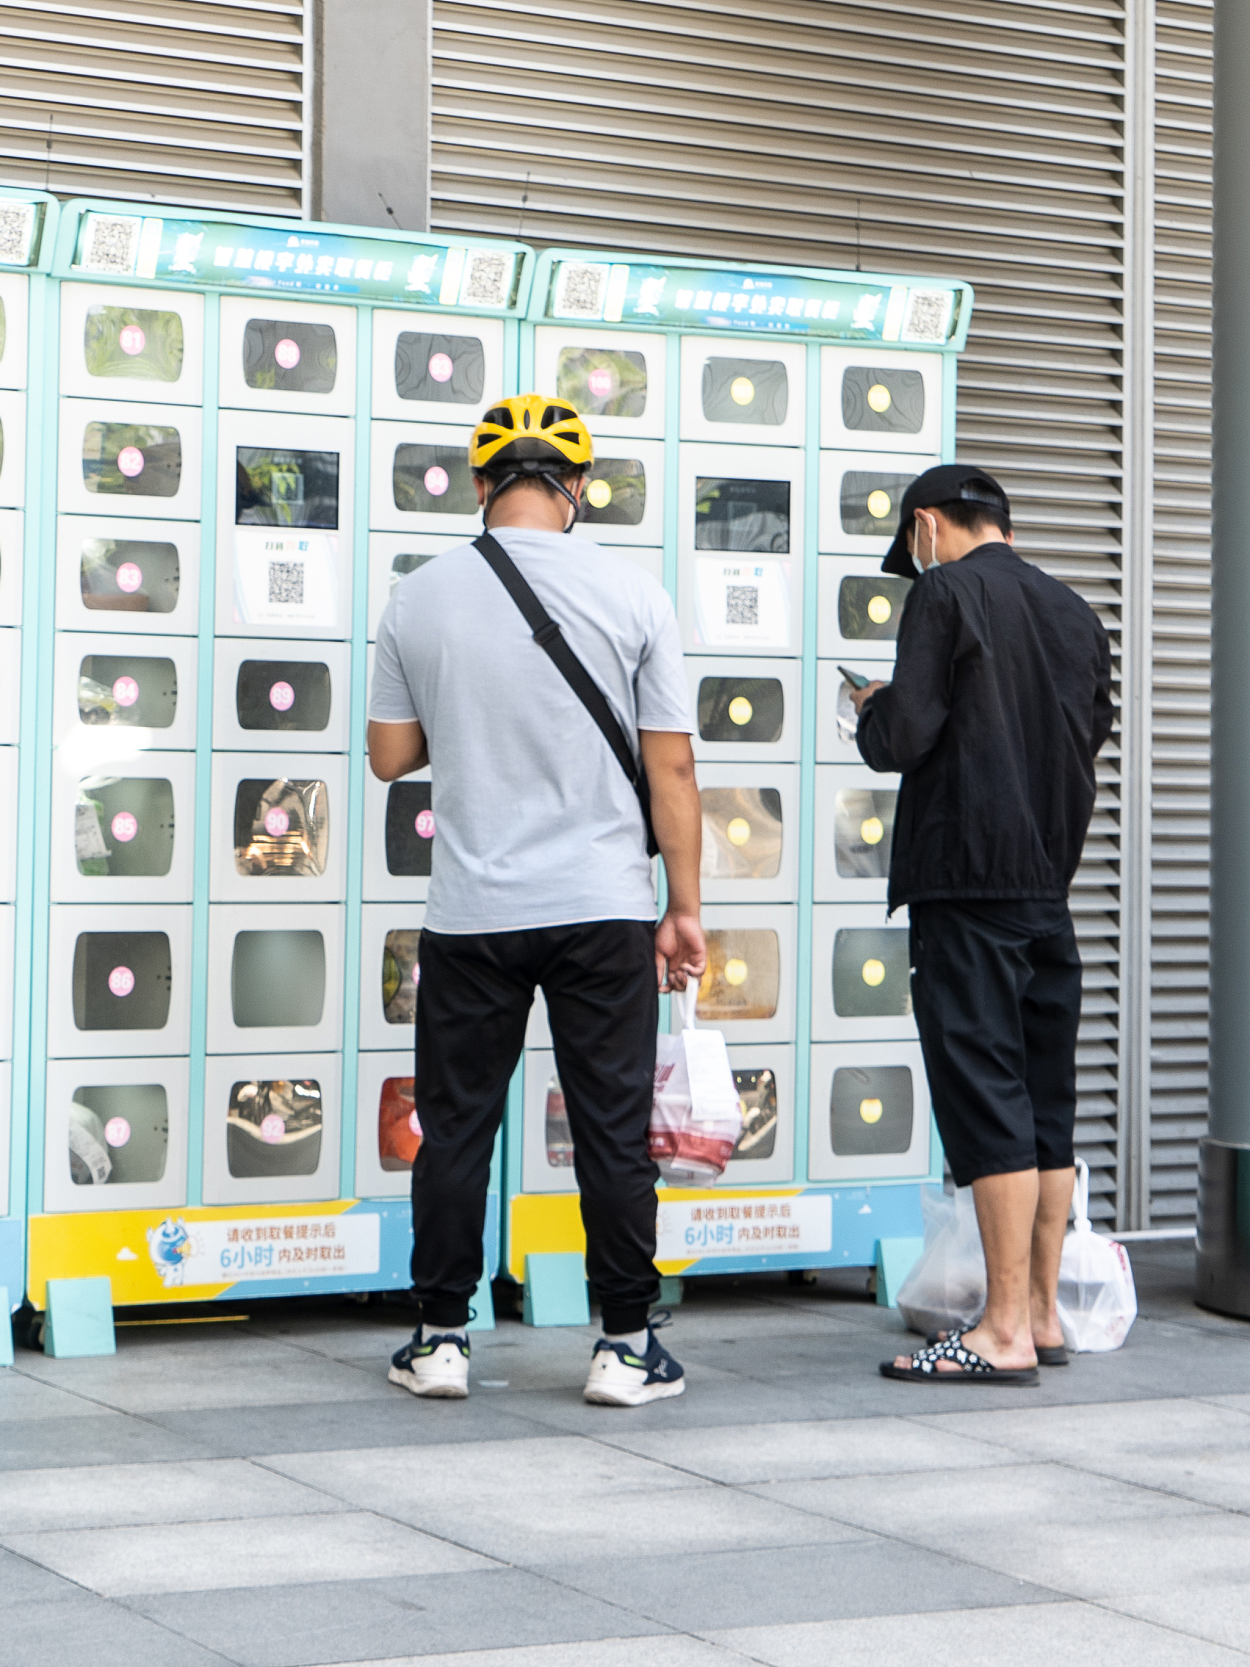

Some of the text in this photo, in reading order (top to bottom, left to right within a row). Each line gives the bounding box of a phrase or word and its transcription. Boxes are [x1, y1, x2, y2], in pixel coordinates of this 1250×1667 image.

[122, 331, 140, 348] 81
[278, 345, 297, 362] 88
[431, 358, 450, 376] 93
[121, 453, 140, 469] 82
[427, 472, 446, 489] 94
[119, 569, 139, 585] 83
[116, 683, 136, 700] 84
[272, 687, 291, 704] 89
[114, 818, 134, 834] 85
[267, 813, 286, 829] 90
[418, 815, 434, 831] 97
[111, 973, 131, 989] 86
[108, 1123, 126, 1140] 87
[263, 1120, 282, 1137] 92
[690, 1203, 792, 1222] 请收到取餐提示后
[227, 1222, 336, 1243] 请收到取餐提示后
[684, 1222, 800, 1246] 6小时 内及时取出
[220, 1244, 346, 1269] 6小时 内及时取出
